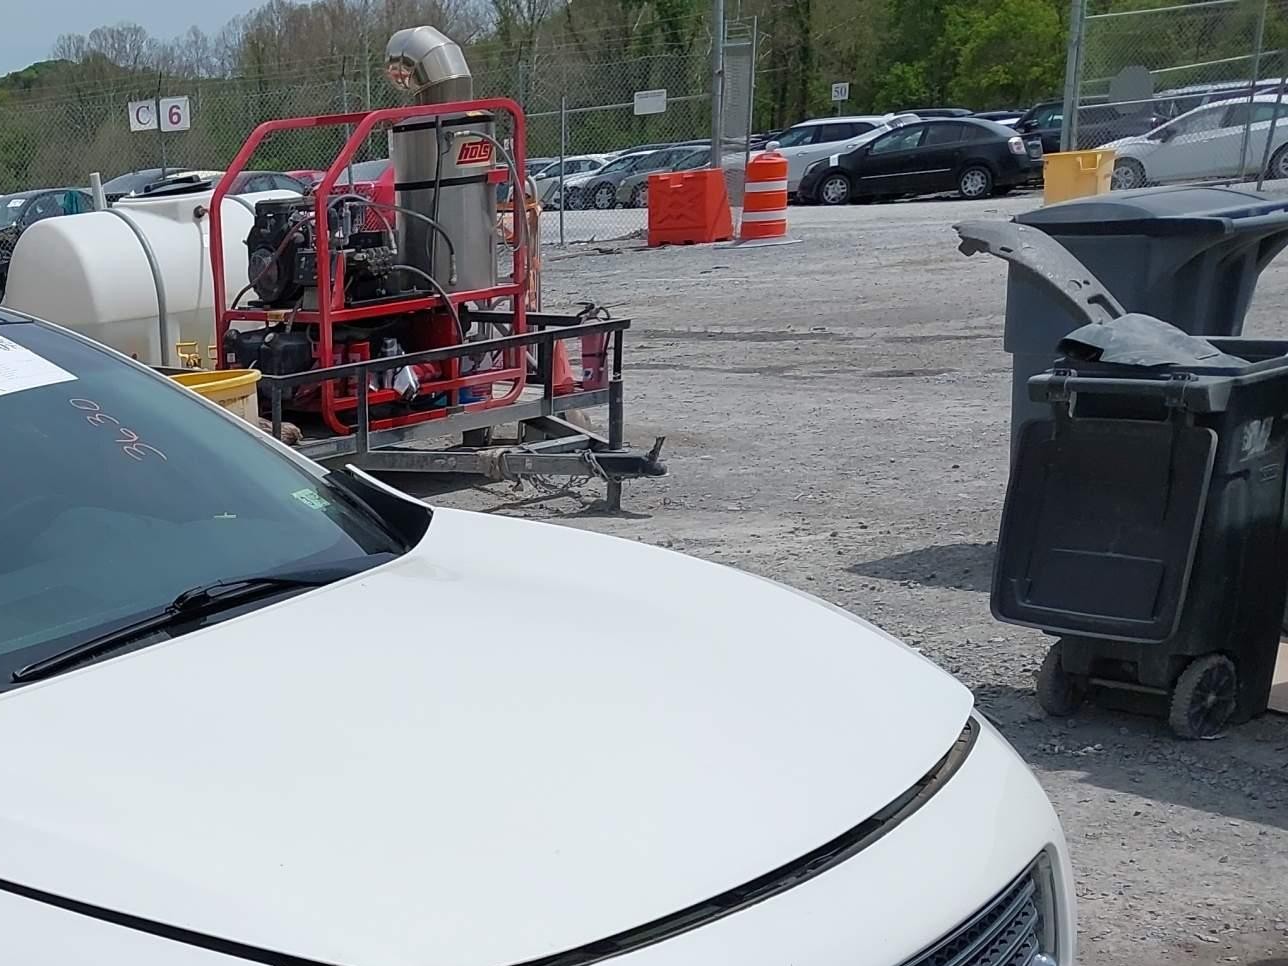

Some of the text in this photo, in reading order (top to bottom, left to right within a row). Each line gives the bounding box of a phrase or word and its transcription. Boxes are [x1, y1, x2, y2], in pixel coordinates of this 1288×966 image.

[834, 86, 847, 98] 50
[136, 105, 150, 125] C
[168, 105, 182, 125] 6
